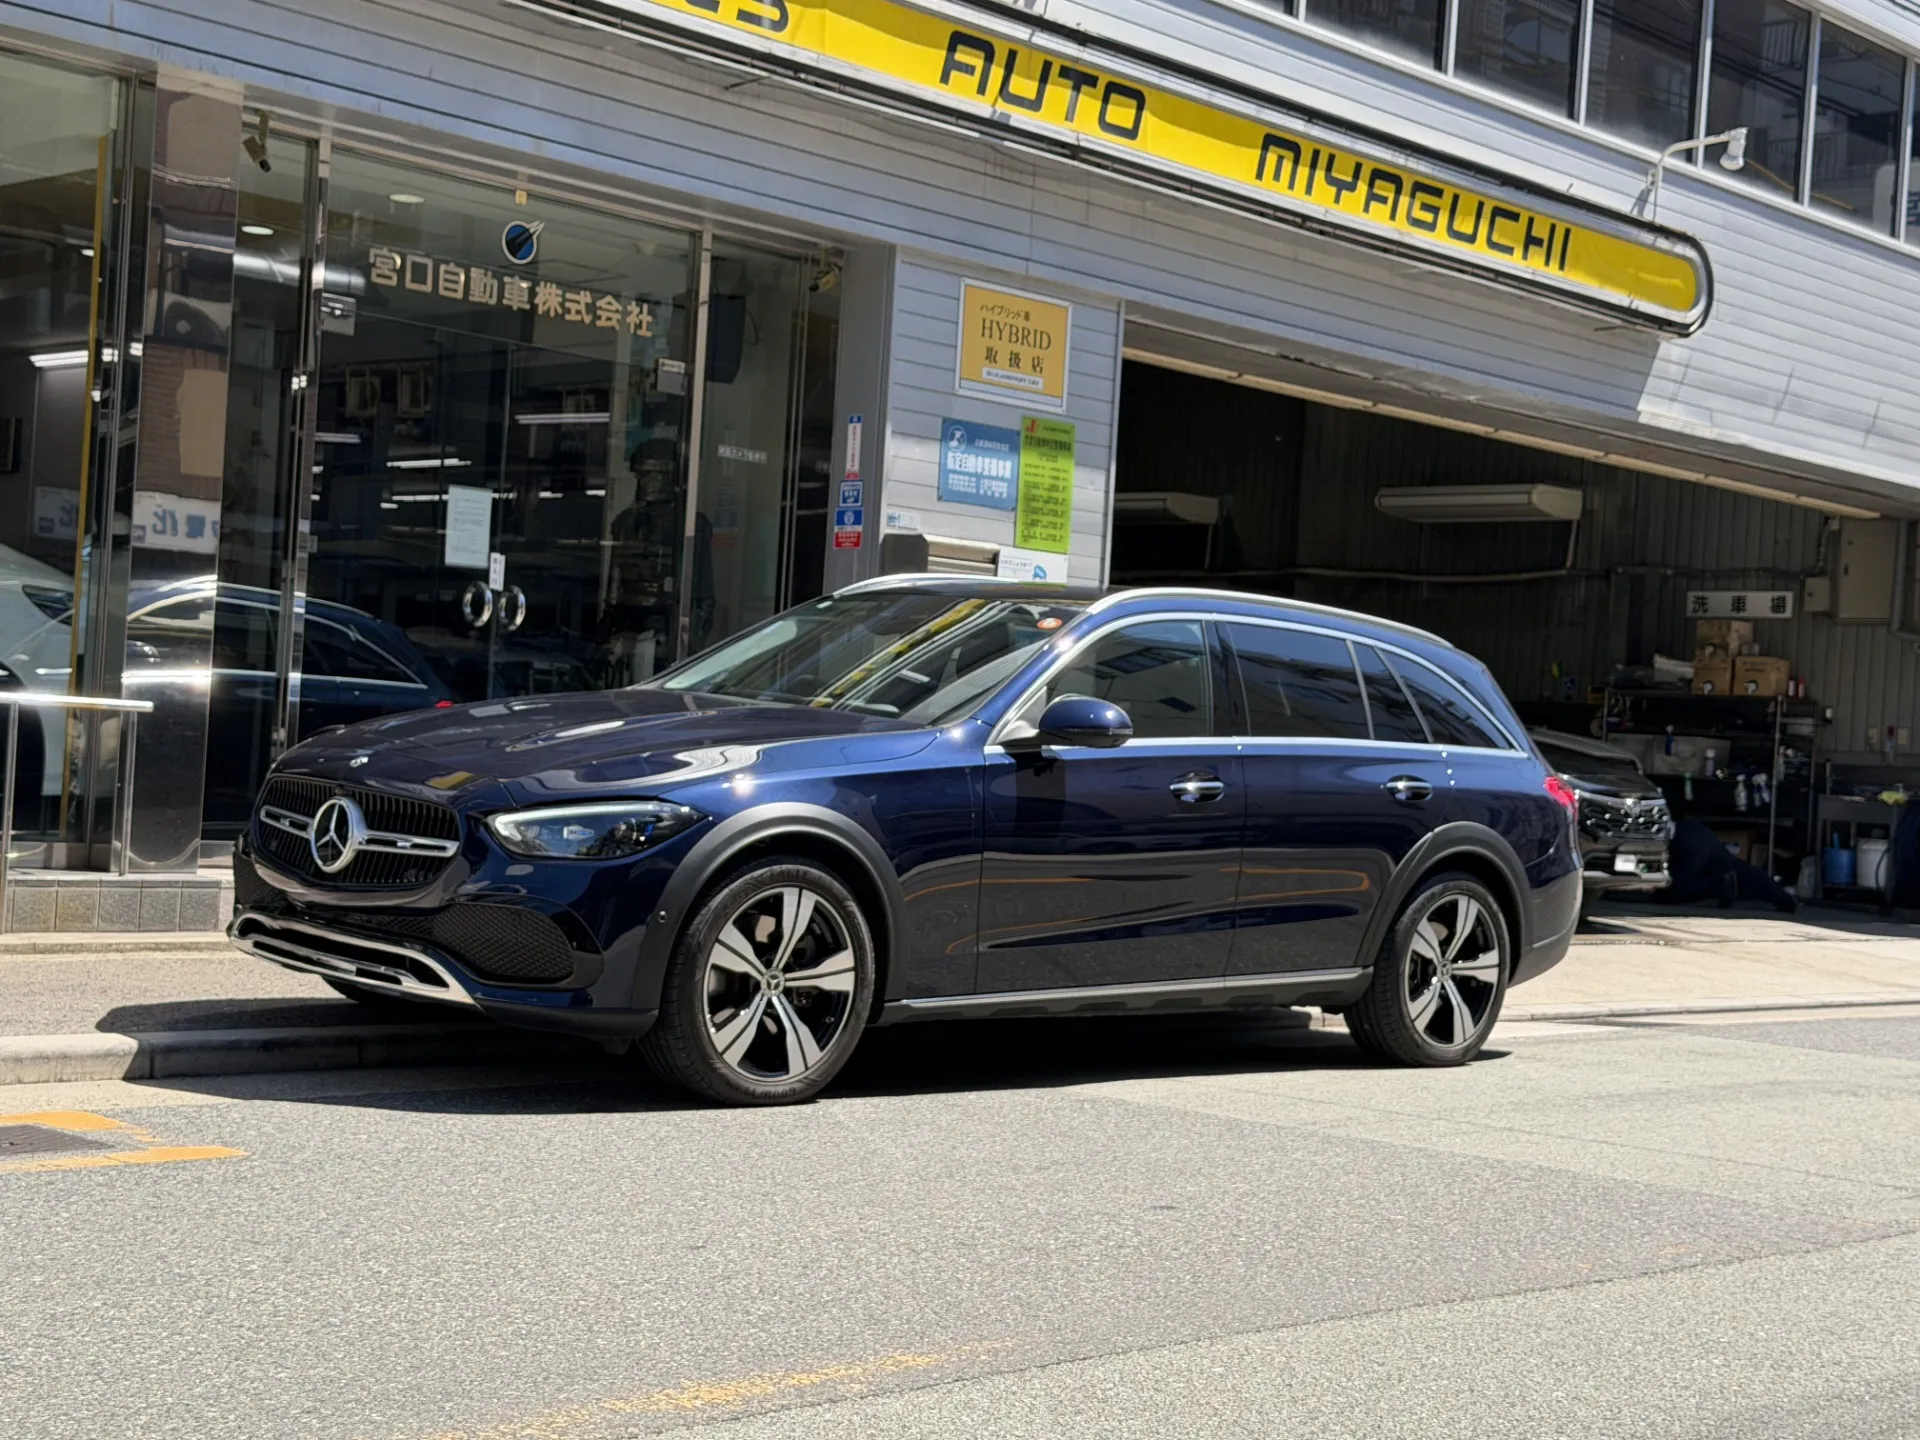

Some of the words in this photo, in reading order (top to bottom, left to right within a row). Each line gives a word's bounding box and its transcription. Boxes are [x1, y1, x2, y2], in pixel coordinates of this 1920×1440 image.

[939, 29, 1147, 141] AUTO
[1255, 132, 1572, 272] MIYAGUCHI
[368, 247, 653, 338] 宮口自動車株式会社
[980, 317, 1052, 351] HYBRID
[984, 345, 1045, 374] 取扱店
[1691, 594, 1787, 614] 洗車場
